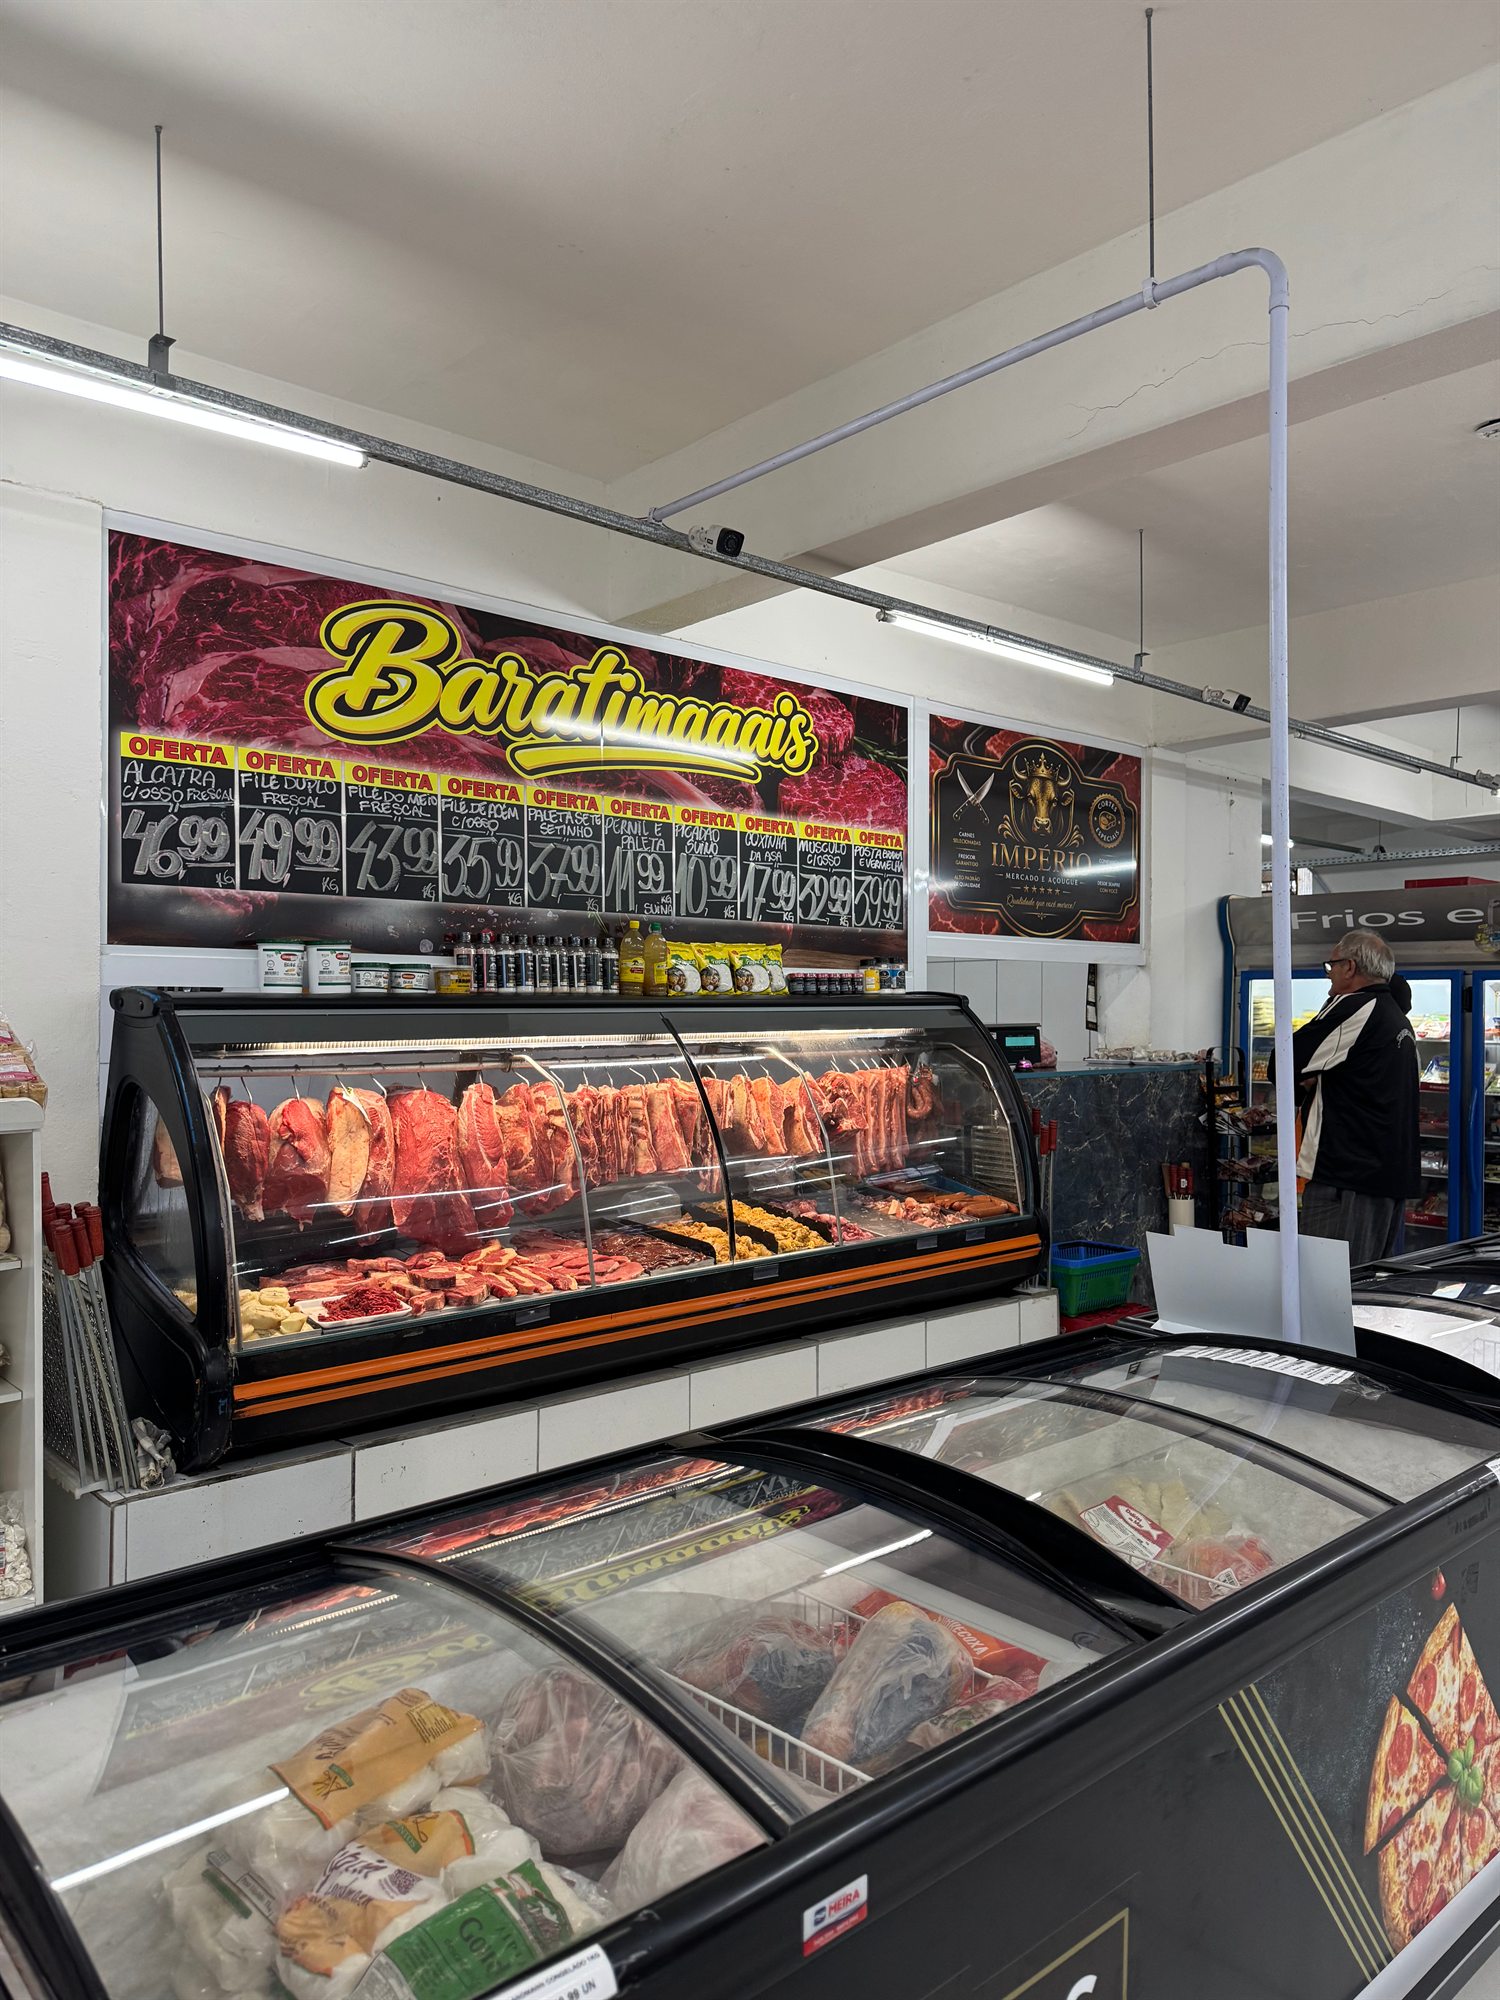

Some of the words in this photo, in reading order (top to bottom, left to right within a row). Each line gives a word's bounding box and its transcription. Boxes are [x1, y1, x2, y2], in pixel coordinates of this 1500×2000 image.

[304, 599, 818, 775] Baratimaaais
[129, 737, 228, 765] OFERTA
[246, 751, 336, 778] OFERTA
[123, 760, 216, 788] ALCATRA
[352, 765, 434, 791] OFERTA
[123, 785, 184, 803] C/OSSO
[187, 787, 235, 802] FRESCAL
[284, 777, 337, 795] DUPLO
[448, 778, 520, 802] OFERTA
[262, 792, 326, 808] FRESCAL
[384, 789, 404, 803] DO
[407, 793, 438, 806] MEIO
[533, 789, 599, 812] OFERTA
[359, 801, 431, 817] FRESCAL
[469, 802, 486, 816] DE
[610, 800, 670, 820] OFERTA
[1097, 800, 1118, 813] CORTES
[604, 816, 649, 836] PERNIL
[654, 823, 663, 836] E
[681, 808, 735, 828] OFERTA
[745, 816, 796, 836] OFERTA
[540, 824, 593, 838] SETINHO
[804, 824, 851, 842] OFERTA
[859, 831, 903, 848] OFERTA
[1095, 827, 1120, 843] ESPECIAIS
[621, 836, 665, 852] PALETA
[745, 832, 787, 852] COXINHA
[749, 850, 763, 862] DA
[764, 851, 782, 862] ASA
[854, 846, 881, 860] POSTA
[991, 842, 1092, 874] IMPÉRIO
[859, 859, 864, 867] E
[216, 870, 235, 888] KG
[322, 876, 339, 894] KG
[1005, 872, 1039, 882] MERCADO
[1048, 877, 1078, 886] AÇOUGUE
[422, 883, 437, 900] KG
[508, 892, 522, 906] KG
[586, 899, 599, 912] KG
[1006, 894, 1035, 908] Qualidade
[1035, 900, 1045, 909] que
[724, 904, 735, 919] KG
[782, 910, 794, 922] KG
[1291, 908, 1426, 930] Frios
[1446, 908, 1485, 924] e
[828, 1889, 860, 1917] MEIRA
[581, 1979, 596, 1995] UN
